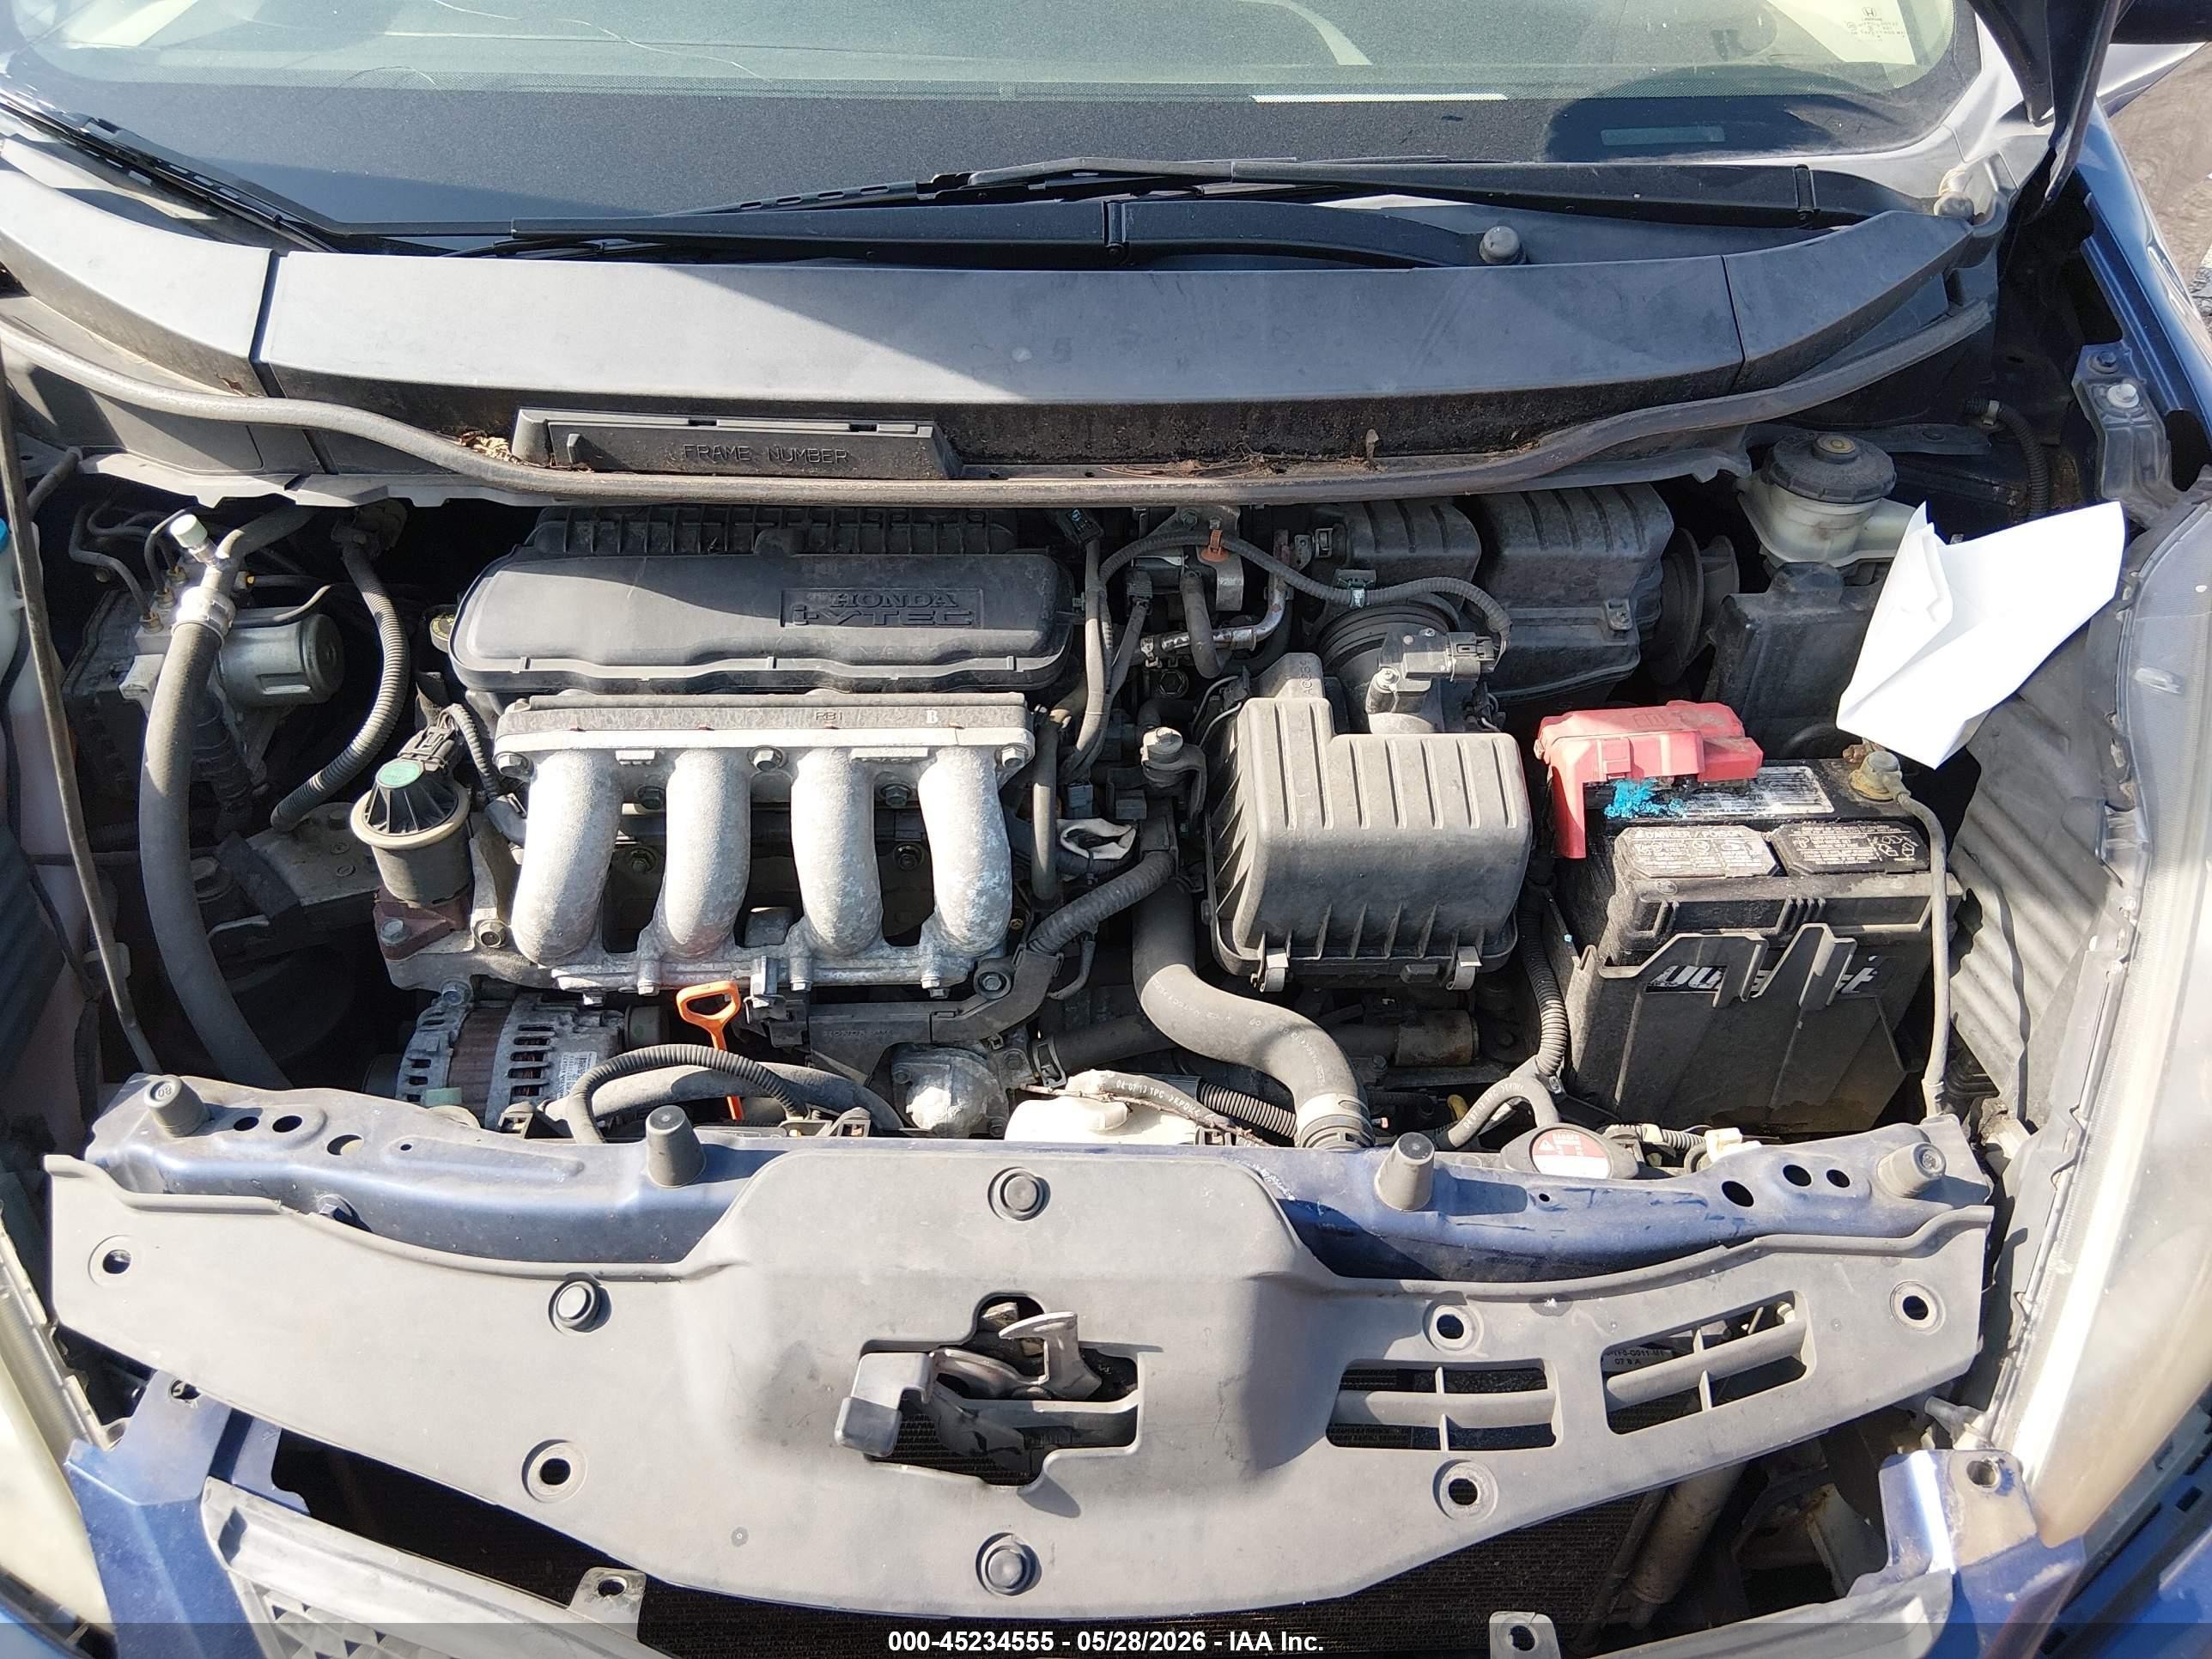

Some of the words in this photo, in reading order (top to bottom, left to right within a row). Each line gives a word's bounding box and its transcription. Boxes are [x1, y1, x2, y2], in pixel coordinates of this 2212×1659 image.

[683, 444, 752, 463] FRAME
[767, 446, 848, 464] NUMBER
[830, 592, 958, 608] HONDA
[792, 604, 973, 626] i-VTEC
